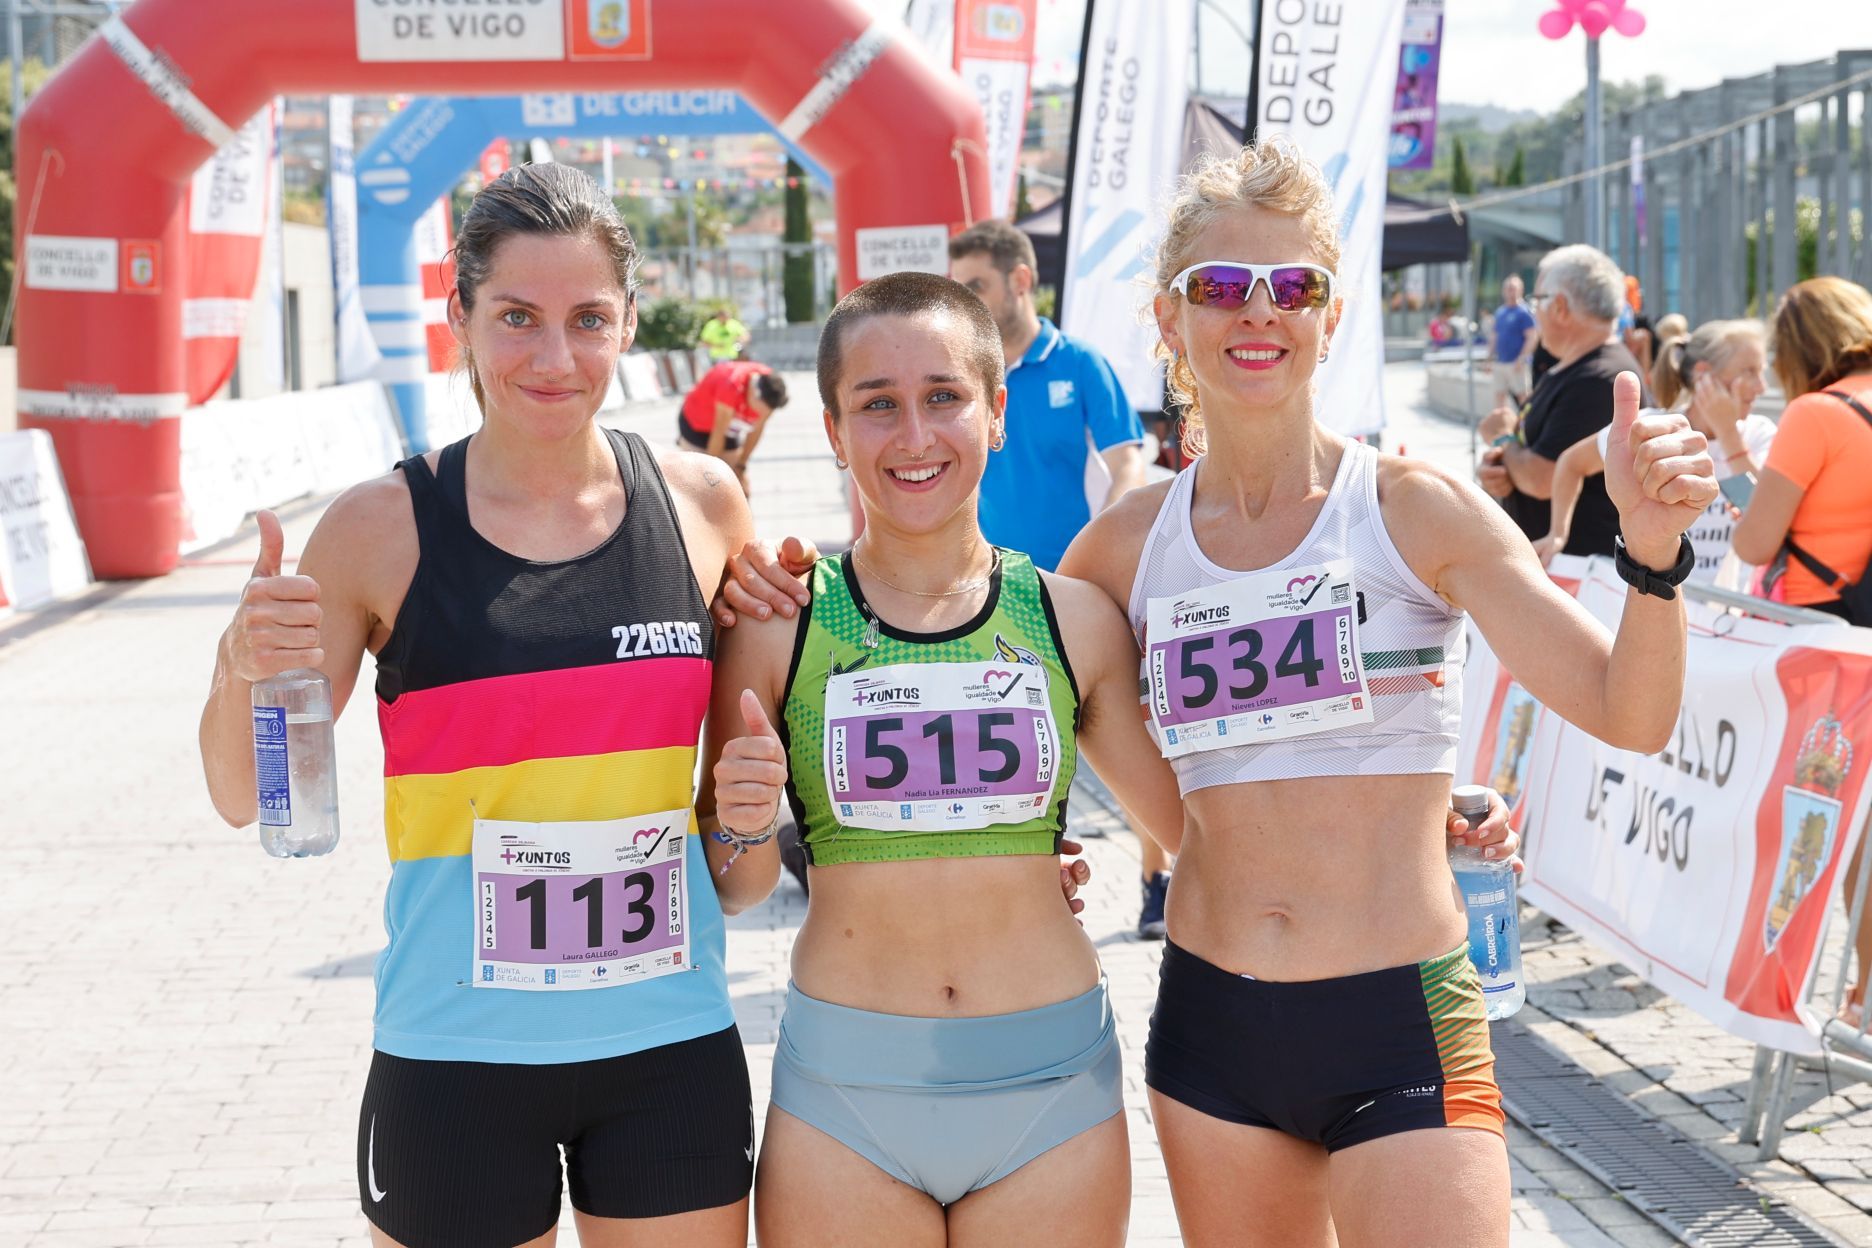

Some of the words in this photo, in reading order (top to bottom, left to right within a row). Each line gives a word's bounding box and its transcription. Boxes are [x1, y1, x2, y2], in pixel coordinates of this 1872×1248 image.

[393, 15, 434, 39] DE
[446, 13, 526, 38] VIGO
[1108, 57, 1140, 190] GALEGO
[1268, 599, 1299, 608] igualdade
[1339, 618, 1347, 628] 6
[611, 621, 703, 659] 226ERS
[1340, 631, 1347, 642] 7
[1340, 644, 1348, 655] 8
[1156, 651, 1162, 661] 1
[1181, 618, 1325, 710] 534
[1342, 658, 1350, 668] 9
[1156, 664, 1162, 675] 2
[1342, 671, 1356, 681] 10
[1157, 677, 1164, 688] 3
[965, 691, 997, 699] igualdade
[1158, 690, 1165, 700] 4
[1160, 703, 1168, 714] 5
[1232, 701, 1255, 711] Nieves
[1256, 697, 1278, 707] LOPEZ
[1036, 719, 1043, 729] 6
[836, 728, 842, 738] 1
[1038, 731, 1045, 742] 7
[836, 741, 843, 751] 2
[865, 712, 1021, 790] 515
[1041, 744, 1048, 754] 8
[836, 755, 843, 765] 3
[1042, 757, 1049, 767] 9
[837, 768, 844, 778] 4
[1038, 771, 1049, 781] 10
[839, 781, 846, 791] 5
[904, 789, 926, 798] Nadia
[941, 786, 989, 795] FERNANDEZ
[1624, 783, 1694, 873] VIGO
[616, 852, 643, 862] igualdade
[671, 870, 677, 881] 6
[486, 884, 491, 894] 1
[671, 883, 677, 894] 7
[486, 897, 493, 907] 2
[671, 897, 677, 907] 8
[486, 910, 493, 921] 3
[515, 871, 656, 950] 113
[671, 910, 678, 920] 9
[486, 924, 493, 934] 4
[670, 924, 681, 934] 10
[486, 937, 493, 948] 5
[562, 953, 583, 961] Laura
[585, 950, 619, 960] GALLEGO
[496, 967, 521, 975] XUNTA
[507, 976, 536, 984] GALICIA
